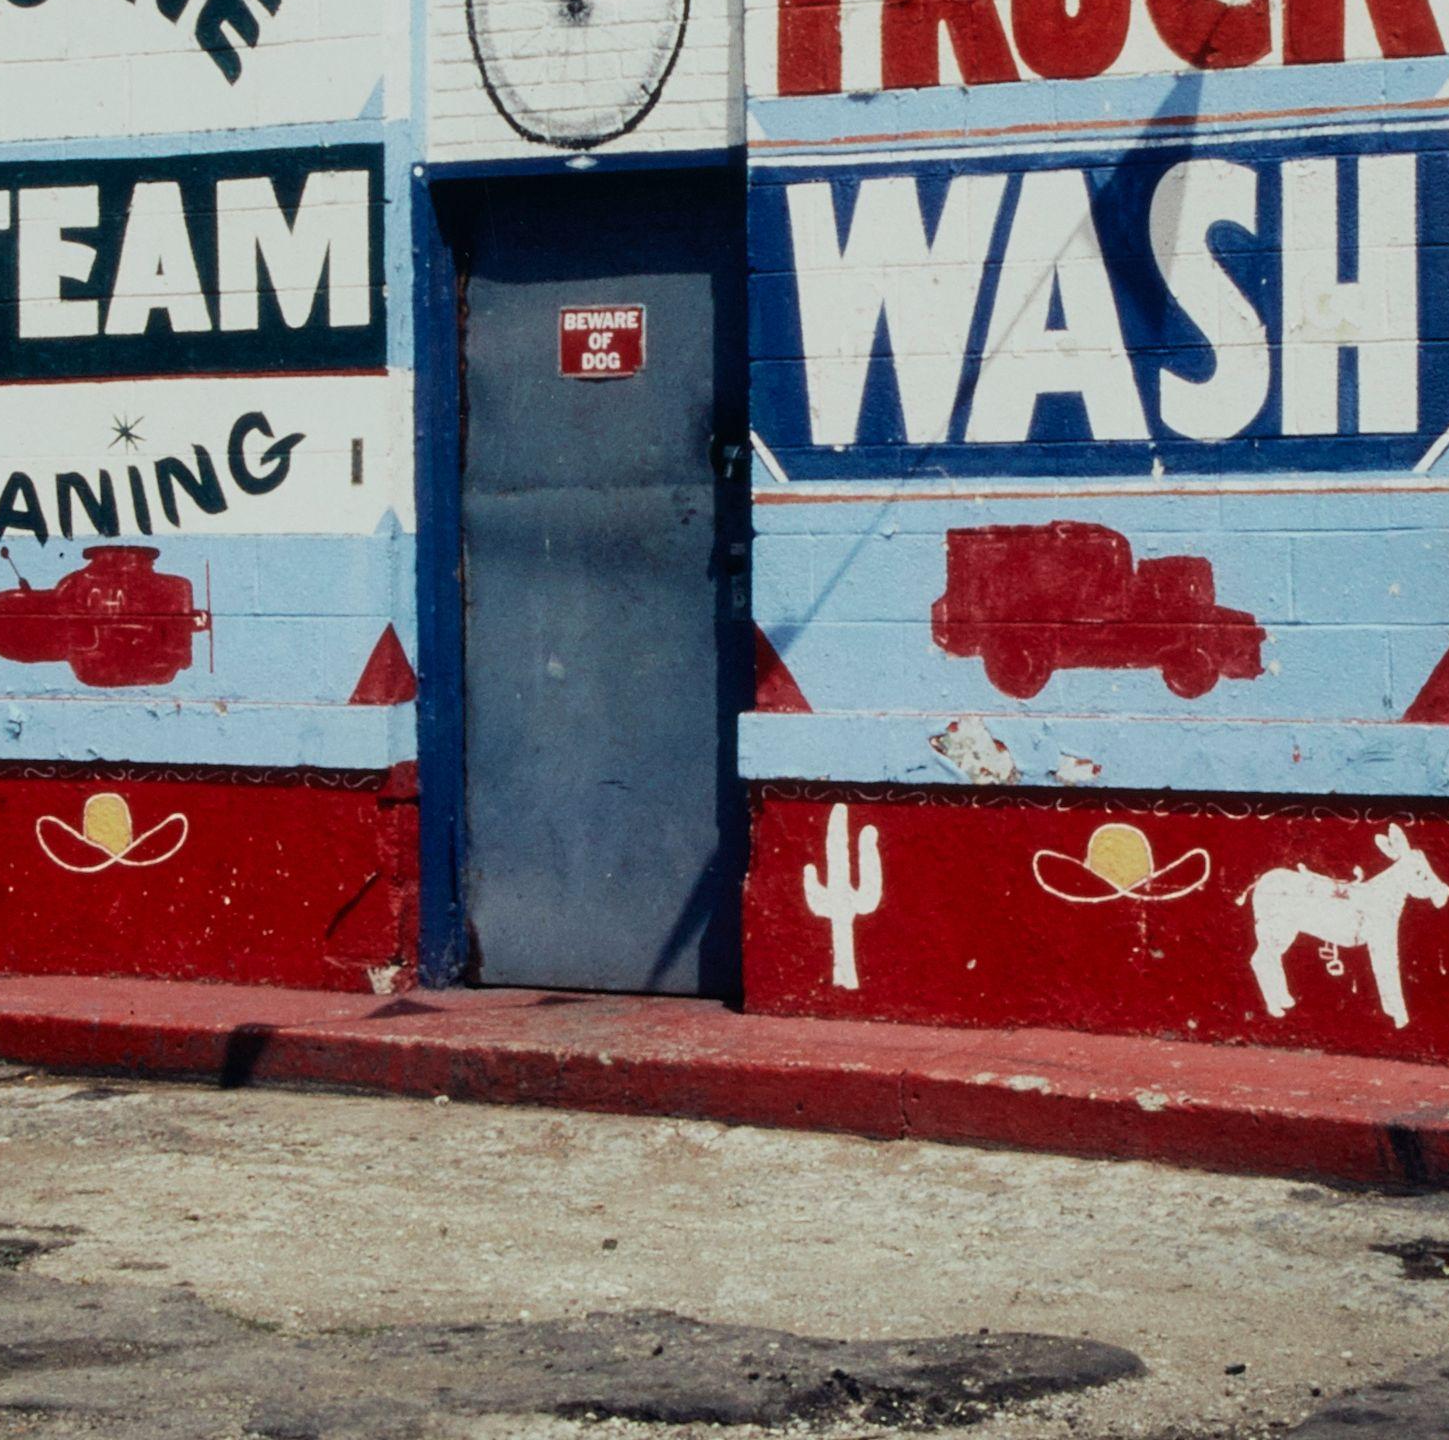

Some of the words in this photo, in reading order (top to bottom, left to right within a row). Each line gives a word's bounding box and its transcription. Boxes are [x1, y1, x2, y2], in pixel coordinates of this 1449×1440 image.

[786, 153, 1419, 448] WASH
[564, 311, 639, 331] BEWARE
[588, 332, 614, 350] OF
[582, 352, 621, 371] DOG
